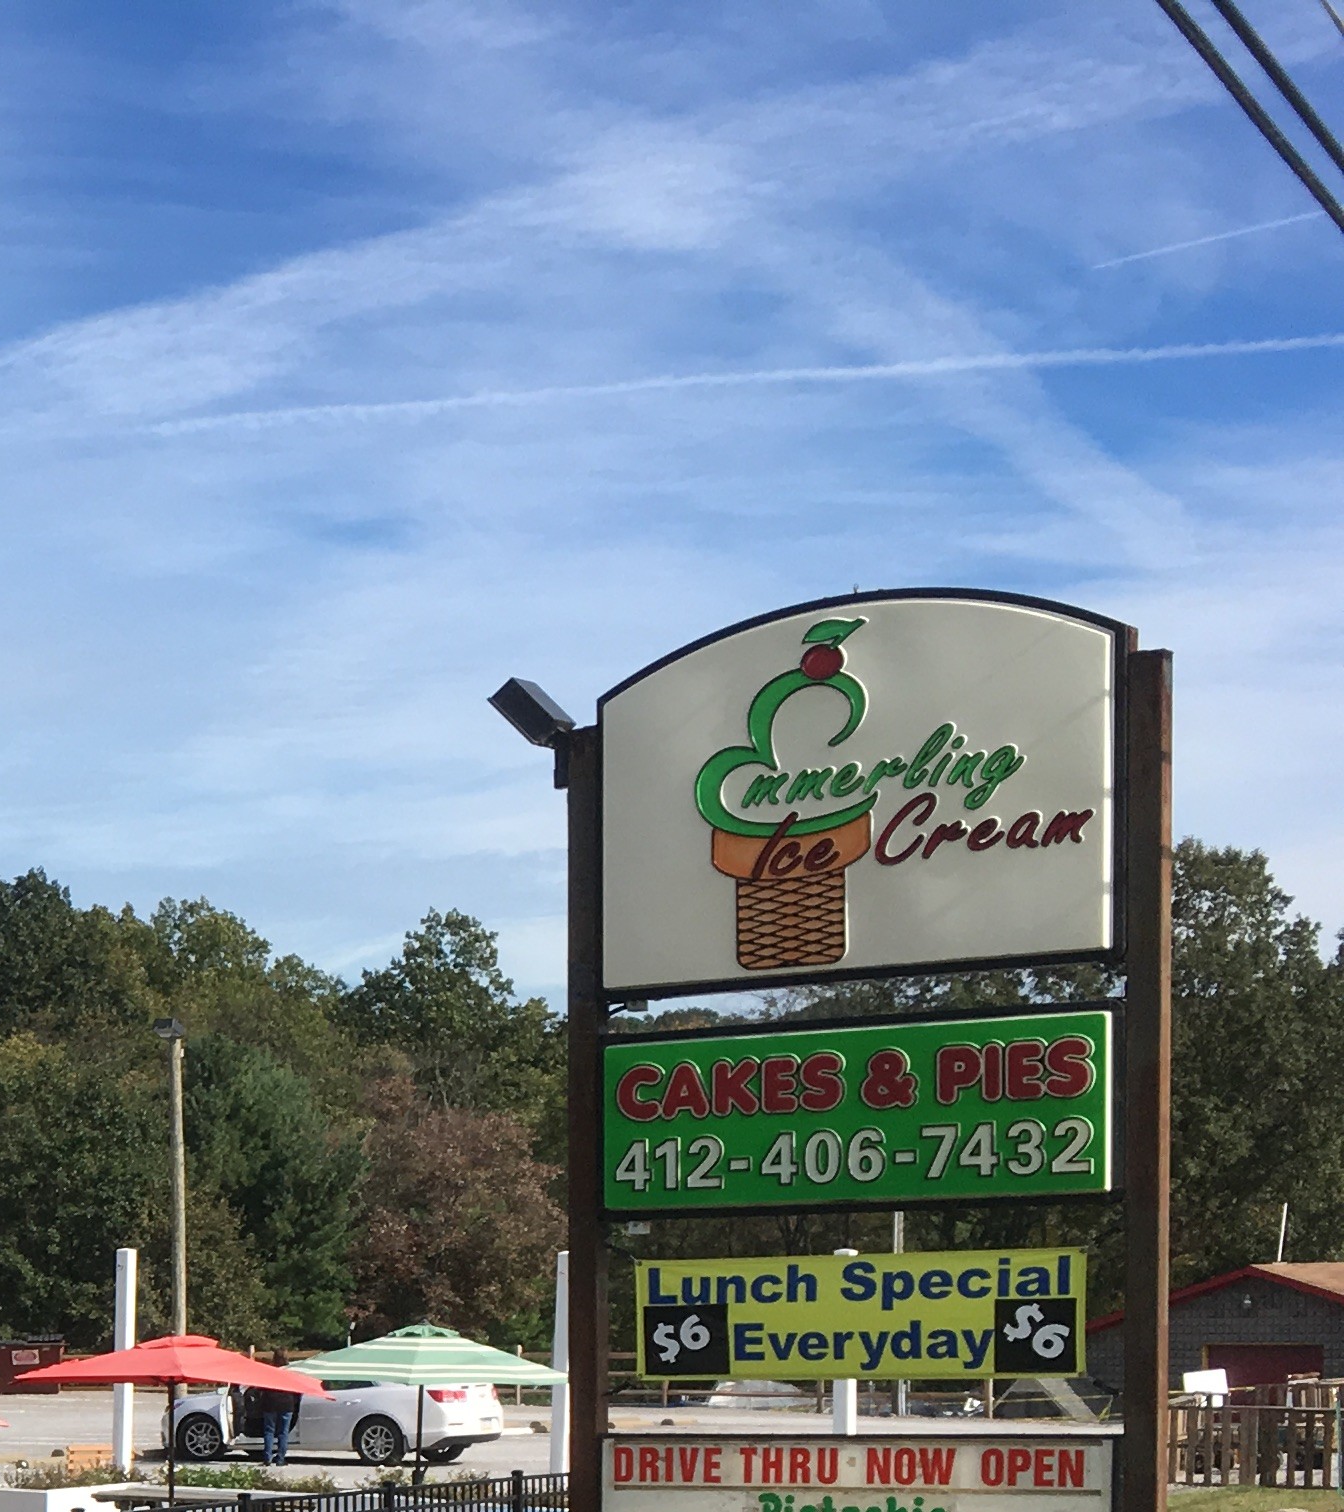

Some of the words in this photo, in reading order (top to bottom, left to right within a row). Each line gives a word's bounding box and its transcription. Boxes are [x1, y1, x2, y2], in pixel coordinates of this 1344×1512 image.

[695, 667, 1026, 838] Emmerling
[751, 812, 843, 880] Ice
[874, 791, 1097, 868] Cream
[616, 1049, 848, 1122] CAKES
[860, 1047, 920, 1110] &
[935, 1033, 1097, 1107] PIES
[614, 1115, 1097, 1192] 412-406-7432
[647, 1262, 819, 1307] Lunch
[840, 1255, 1072, 1311] Special
[652, 1313, 711, 1365] $6
[733, 1320, 994, 1372] Everyday
[1003, 1303, 1071, 1360] $6
[613, 1446, 723, 1484] DRIVE
[740, 1447, 839, 1485] THRU
[866, 1447, 957, 1486] NOW
[980, 1448, 1085, 1488] OPEN
